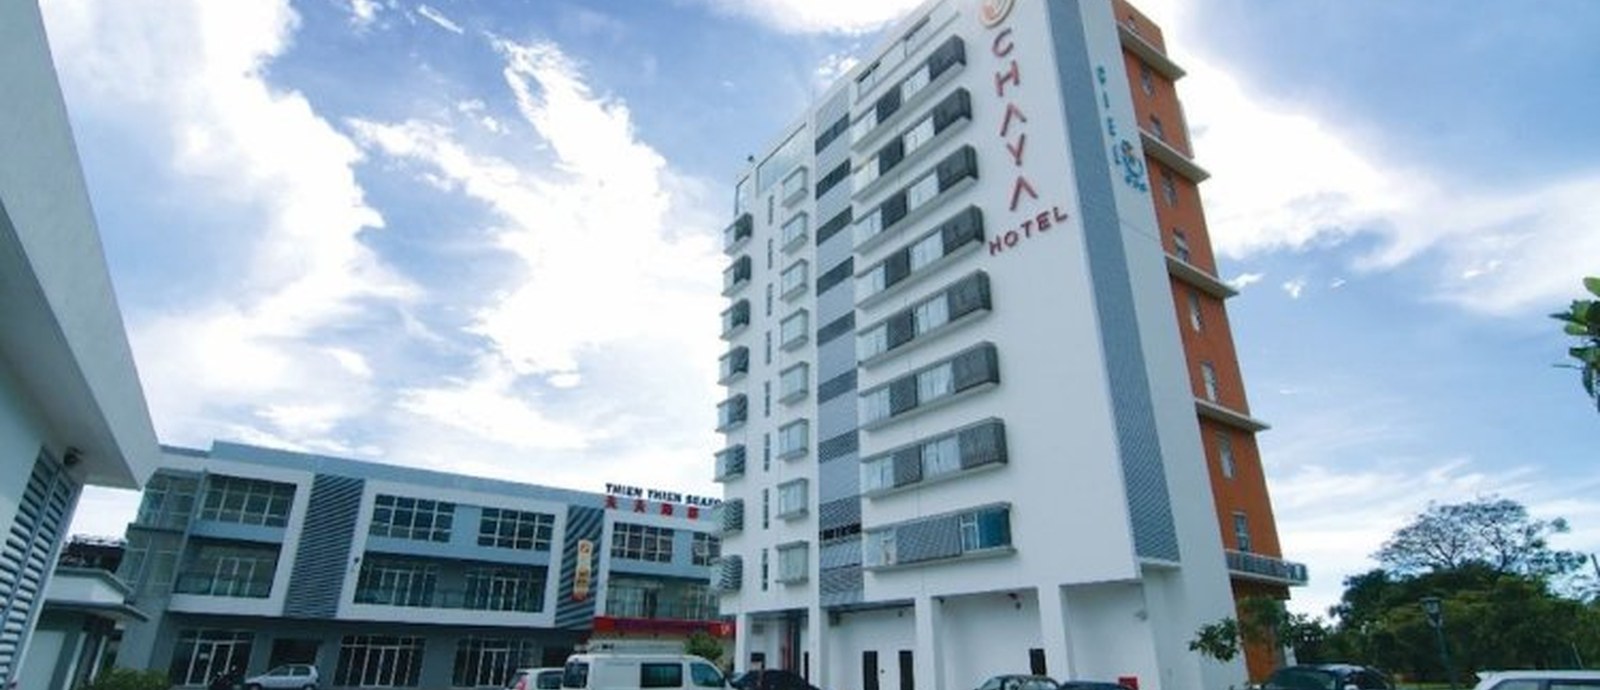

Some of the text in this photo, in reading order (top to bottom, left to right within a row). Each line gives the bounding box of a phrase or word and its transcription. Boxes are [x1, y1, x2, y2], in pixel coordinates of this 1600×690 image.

[992, 27, 1038, 212] CHAYA
[988, 206, 1069, 256] HOTEL
[605, 483, 643, 497] THIEN
[647, 489, 682, 502] THIEN
